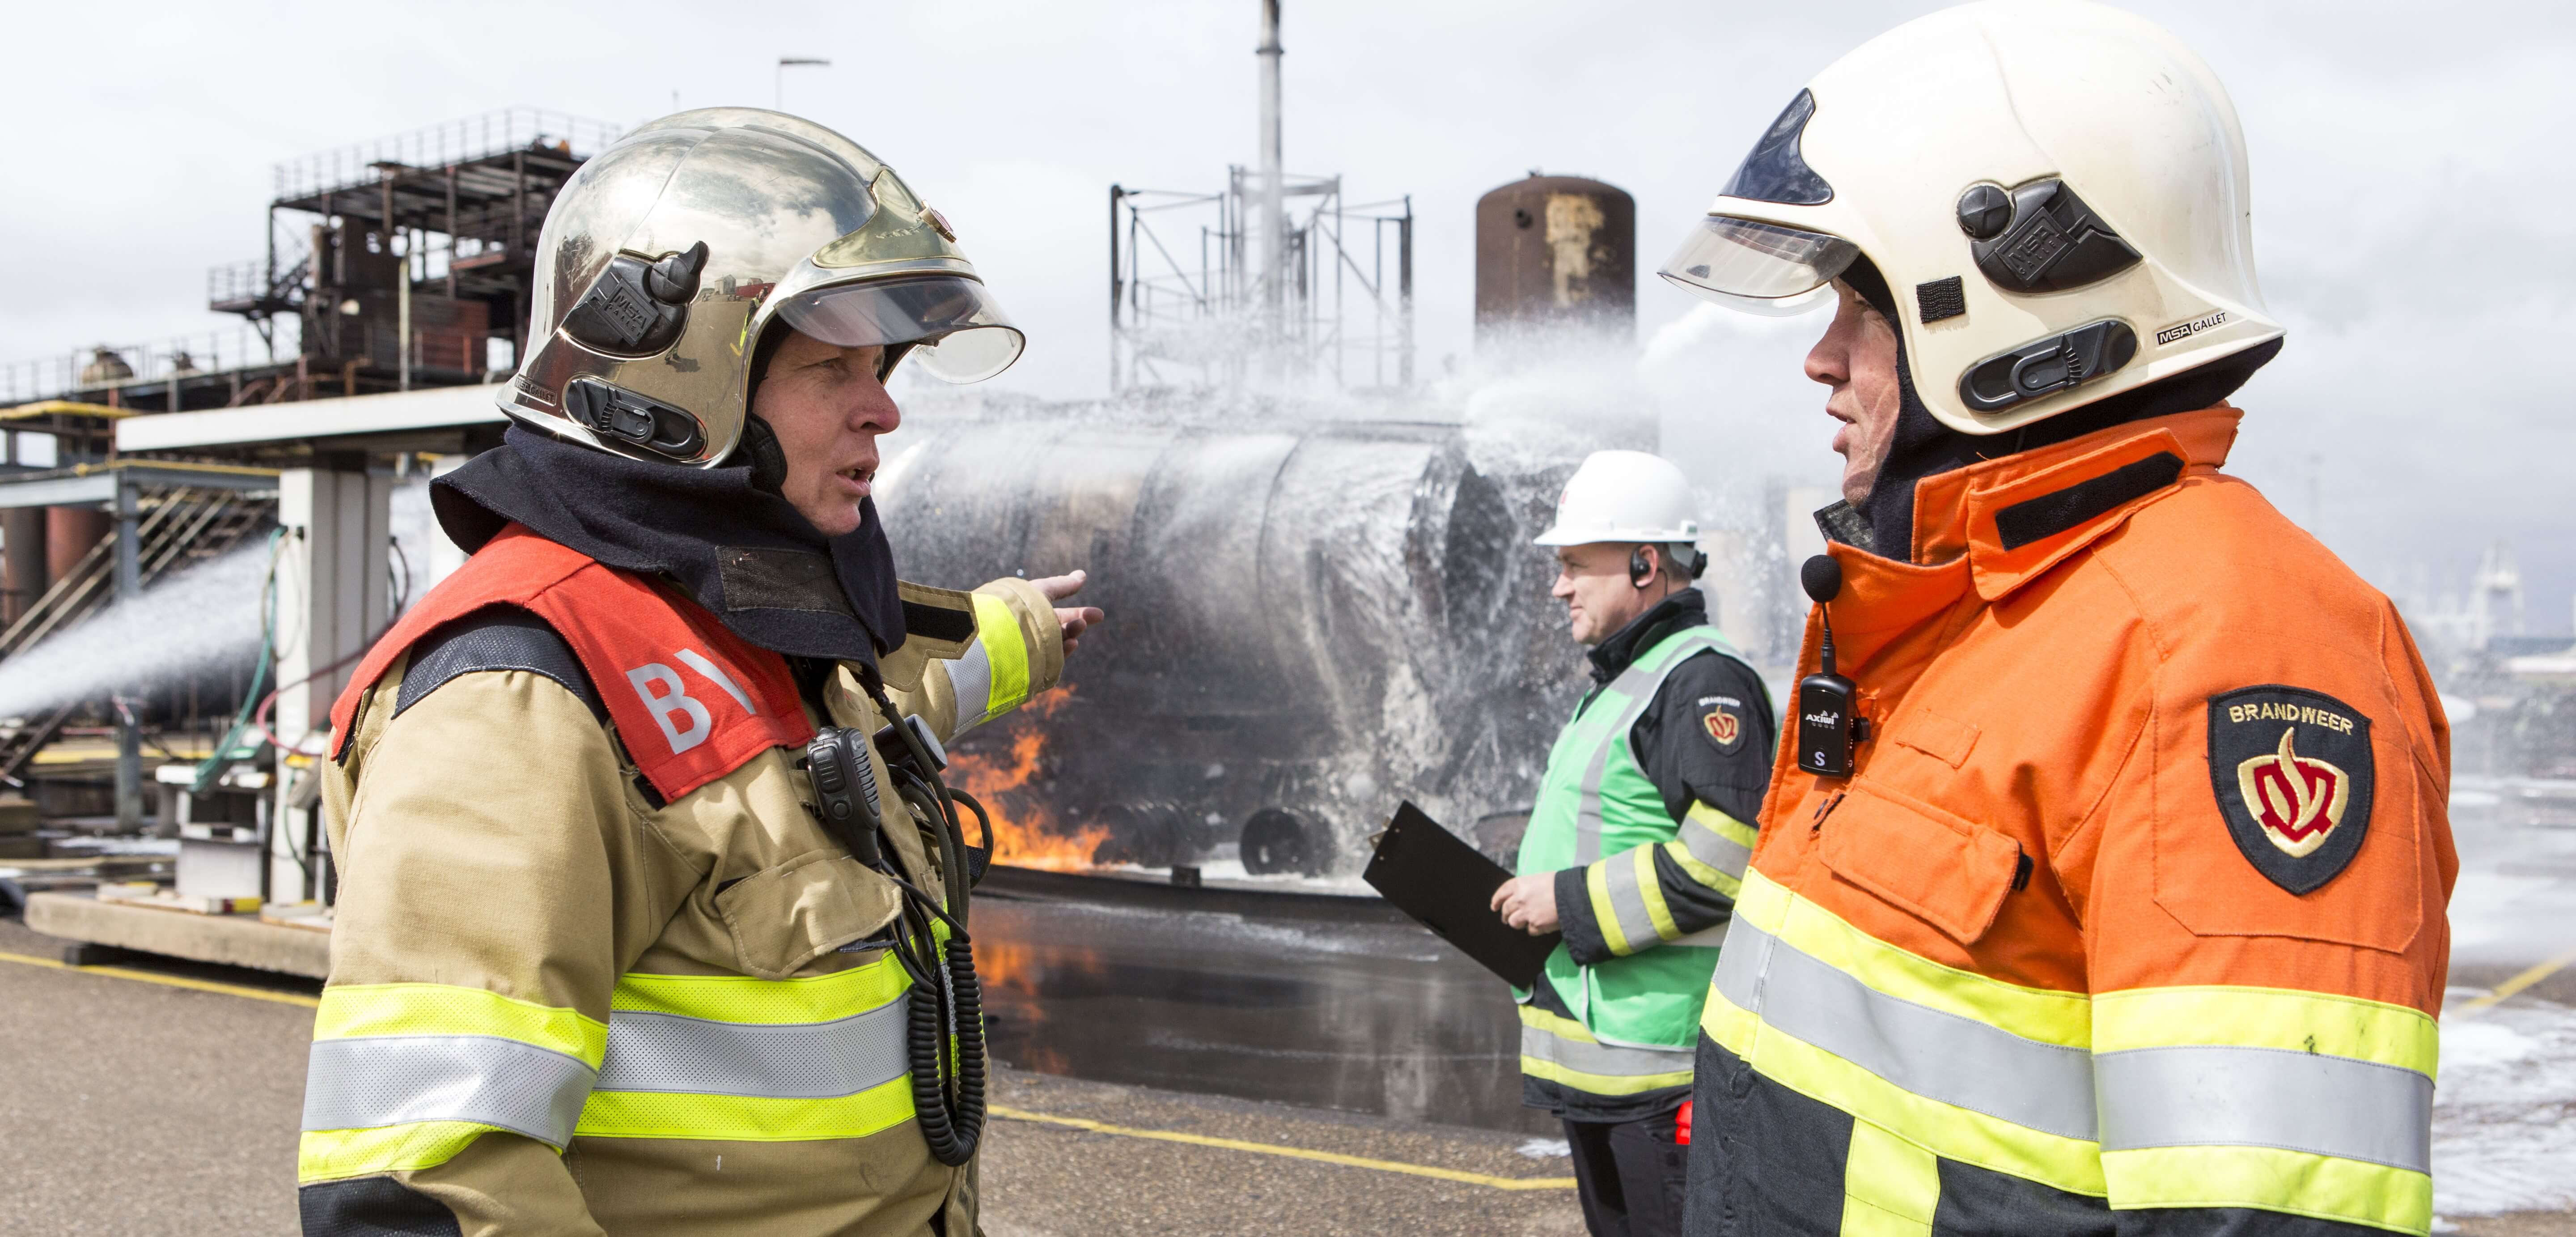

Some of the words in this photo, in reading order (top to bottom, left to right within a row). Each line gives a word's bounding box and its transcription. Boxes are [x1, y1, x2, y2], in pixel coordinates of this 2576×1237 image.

[2008, 225, 2055, 269] MSA
[614, 292, 647, 329] MSA
[2159, 325, 2191, 344] MSA
[2193, 312, 2226, 332] GALLET
[530, 386, 554, 402] GALLET
[2229, 702, 2354, 735] BRANDWEER
[1814, 752, 1825, 766] S
